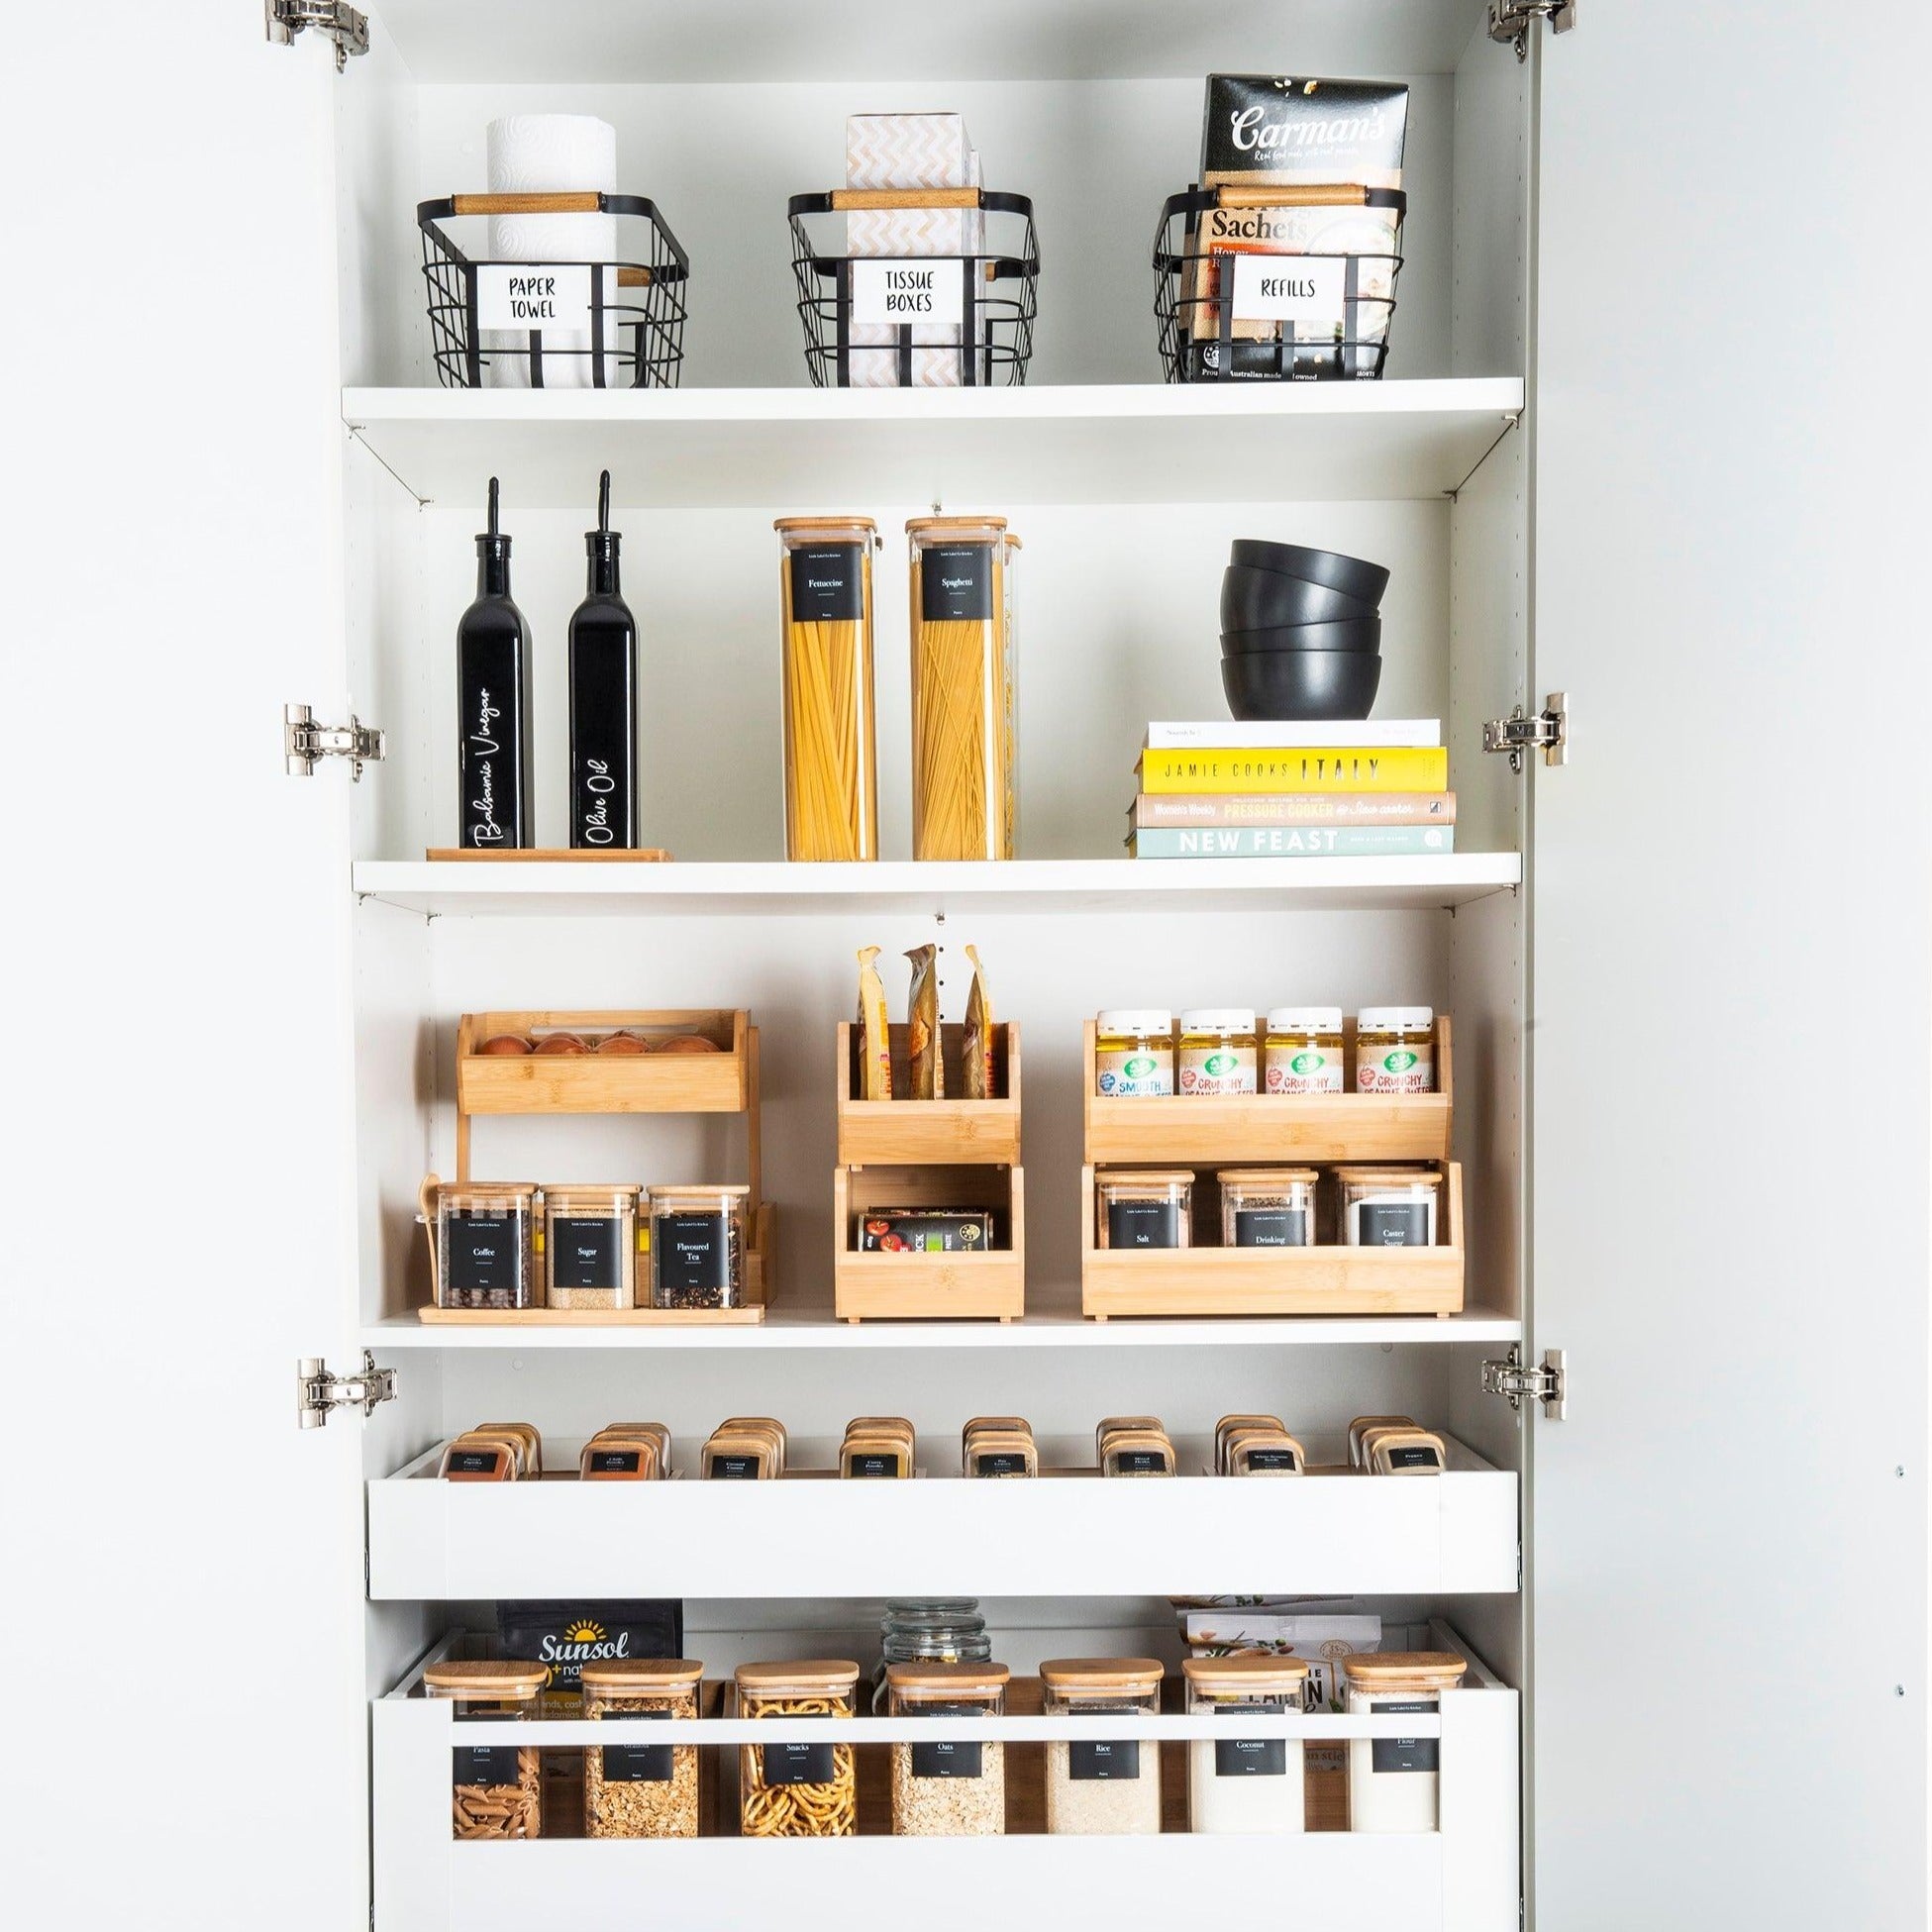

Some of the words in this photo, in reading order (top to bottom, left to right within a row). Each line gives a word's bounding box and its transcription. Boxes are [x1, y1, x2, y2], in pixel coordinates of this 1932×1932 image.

[1231, 106, 1385, 151] Carman's
[1211, 210, 1308, 239] Sachets
[508, 276, 556, 298] PAPER
[885, 270, 934, 290] TISSUE
[1261, 278, 1316, 298] REFILLS
[509, 301, 557, 319] TOWEL
[886, 294, 933, 313] BOXES
[808, 578, 844, 588] Fettuccine
[941, 577, 973, 588] Spaghetti
[469, 687, 501, 757] Vinegar
[586, 759, 615, 793] Oil
[1165, 763, 1219, 777] JAMIE
[1232, 763, 1288, 777] COOKS
[1301, 759, 1379, 780] ITALY
[472, 761, 504, 847] Balsamic
[585, 797, 614, 844] Olive
[1179, 831, 1240, 853] NEW
[1254, 830, 1338, 853] FEAST
[1377, 1073, 1423, 1086] CRUNCHY
[1136, 1234, 1150, 1243] Salt
[1255, 1235, 1285, 1245] Drinking
[1382, 1228, 1404, 1238] Caster
[472, 1247, 495, 1257] Coffee
[577, 1247, 597, 1258] Sugar
[676, 1242, 710, 1252] Flavoured
[686, 1252, 700, 1262] Tea
[538, 1631, 630, 1662] Sunsol
[785, 1743, 810, 1752] Snacks
[937, 1742, 955, 1752] Oats
[1095, 1744, 1111, 1753] Rice
[1236, 1740, 1266, 1750] Coconut
